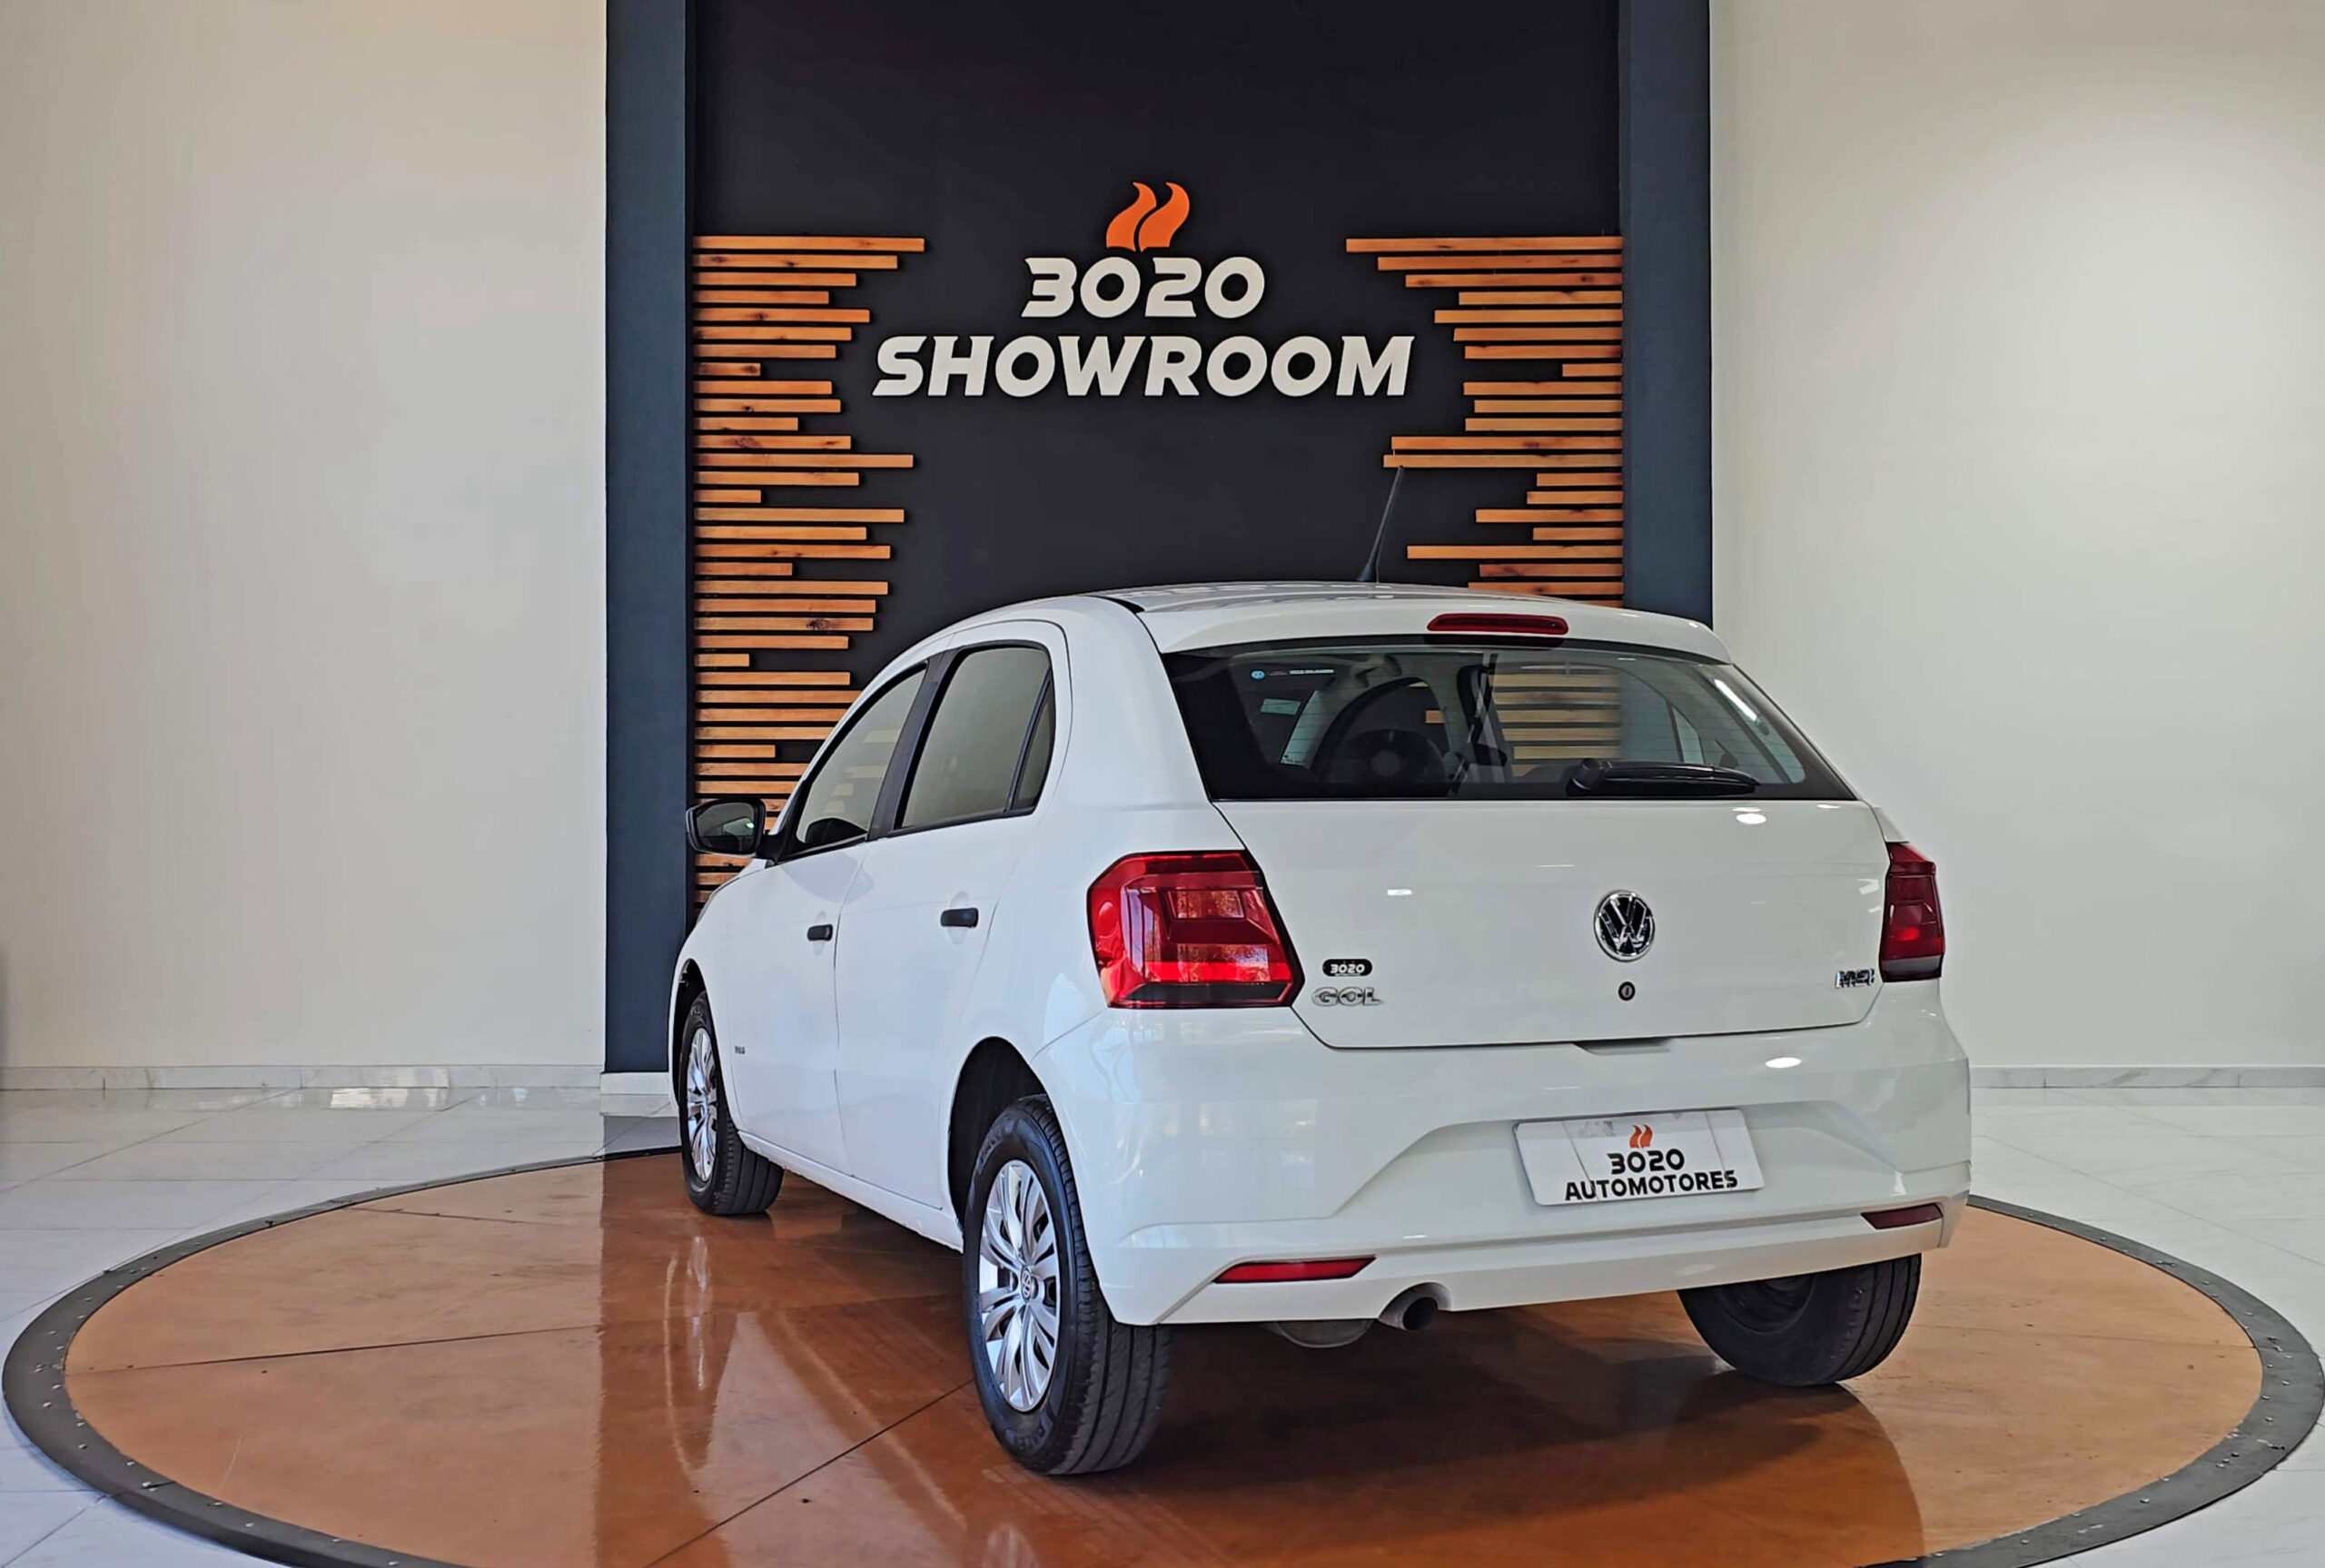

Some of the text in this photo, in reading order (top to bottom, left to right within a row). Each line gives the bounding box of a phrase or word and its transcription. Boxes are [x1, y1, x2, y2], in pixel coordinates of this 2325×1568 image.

[1022, 257, 1264, 318] 3020
[873, 336, 1414, 397] SHOWROOM
[1330, 963, 1365, 974] 3020
[1312, 987, 1383, 1007] GOL
[1608, 1149, 1684, 1177] 3020
[1565, 1169, 1738, 1201] AUTOMOTORES
